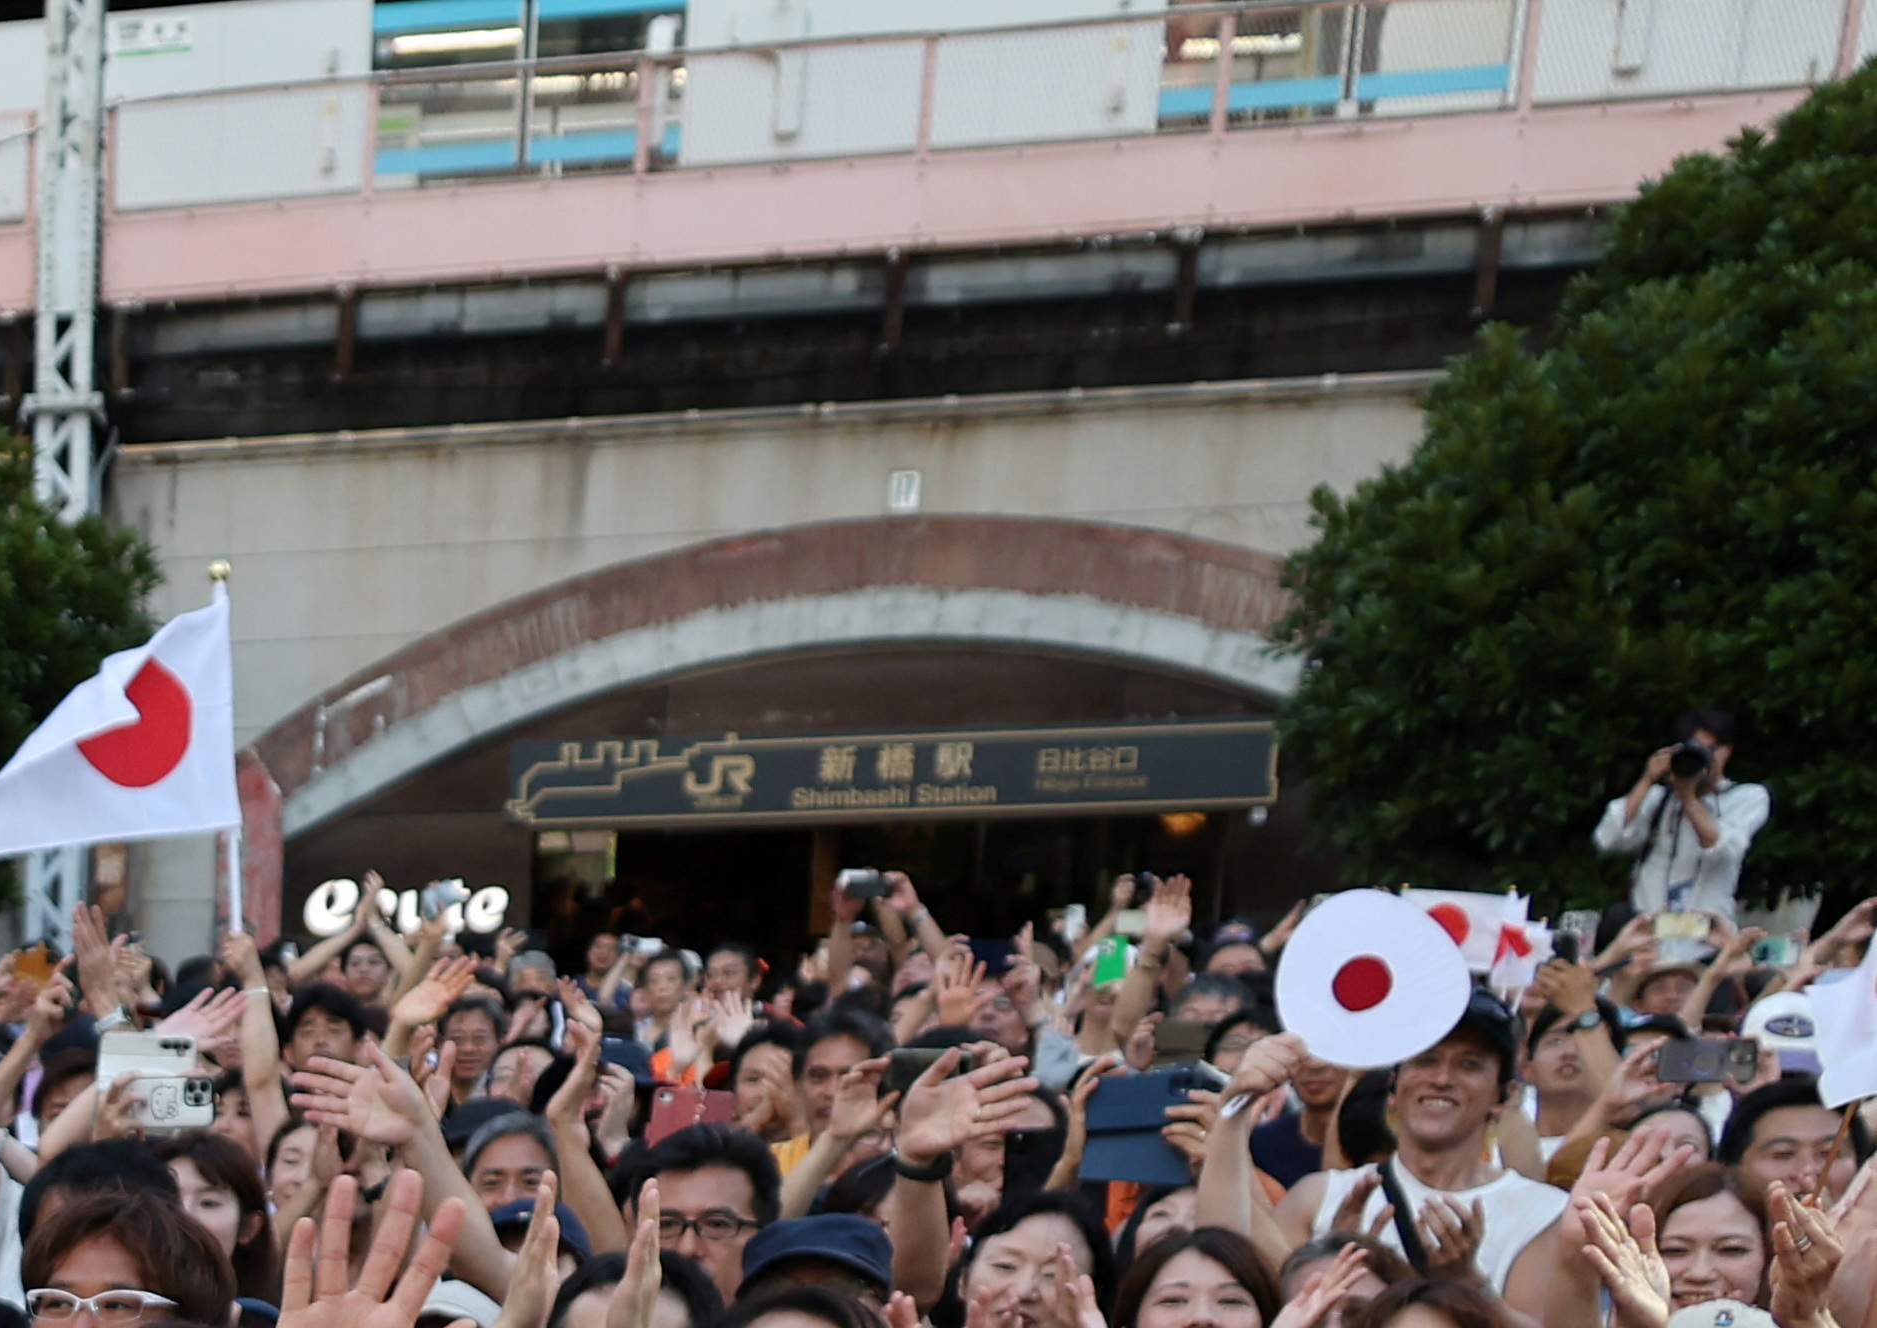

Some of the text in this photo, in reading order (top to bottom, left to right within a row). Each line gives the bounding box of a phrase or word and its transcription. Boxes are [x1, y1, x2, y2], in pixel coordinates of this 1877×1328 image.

[685, 754, 757, 794] JR
[818, 740, 1140, 782] 新橋駅 日比谷口
[791, 777, 998, 808] Shimbashi Station
